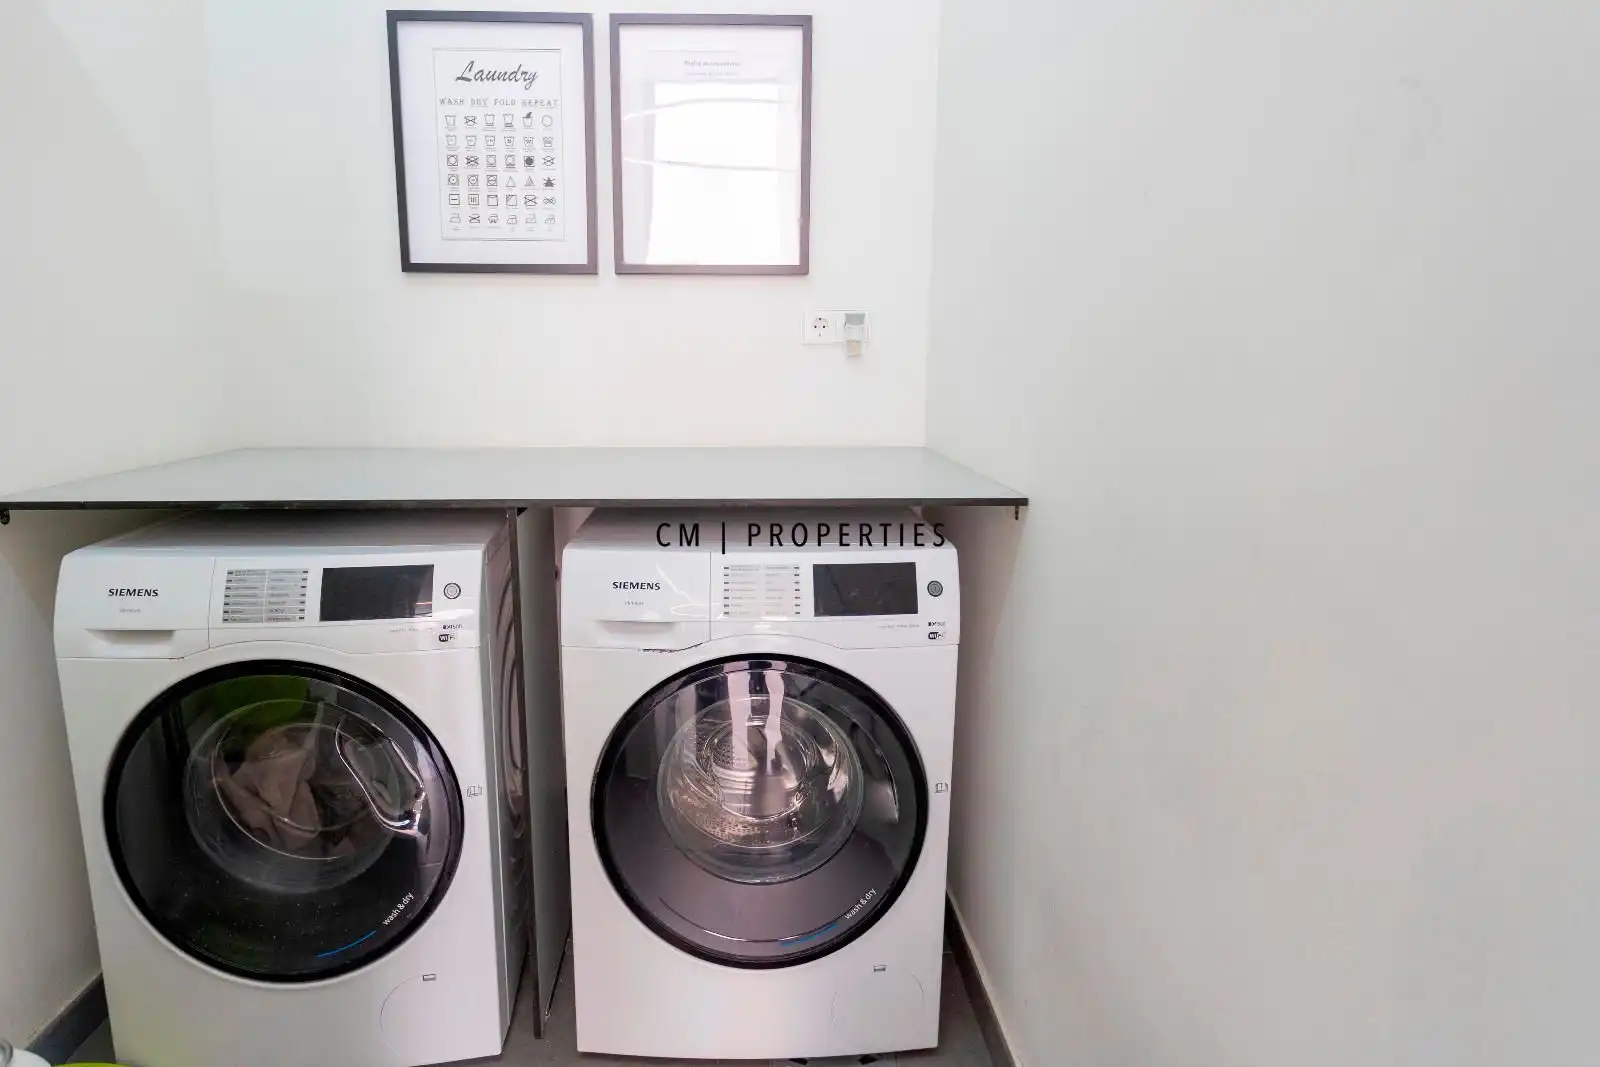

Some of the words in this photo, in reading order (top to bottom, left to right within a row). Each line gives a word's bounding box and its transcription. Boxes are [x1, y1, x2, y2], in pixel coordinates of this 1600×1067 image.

[455, 60, 538, 90] Laundry
[439, 97, 464, 106] WASH
[470, 98, 489, 107] DRY
[494, 98, 516, 106] FOLD
[521, 98, 560, 108] REPEAT
[108, 588, 159, 597] SIEMENS
[612, 581, 661, 591] SIEMENS
[382, 909, 401, 925] wash
[402, 892, 415, 905] dry
[845, 904, 863, 919] wash
[865, 888, 877, 900] dry
